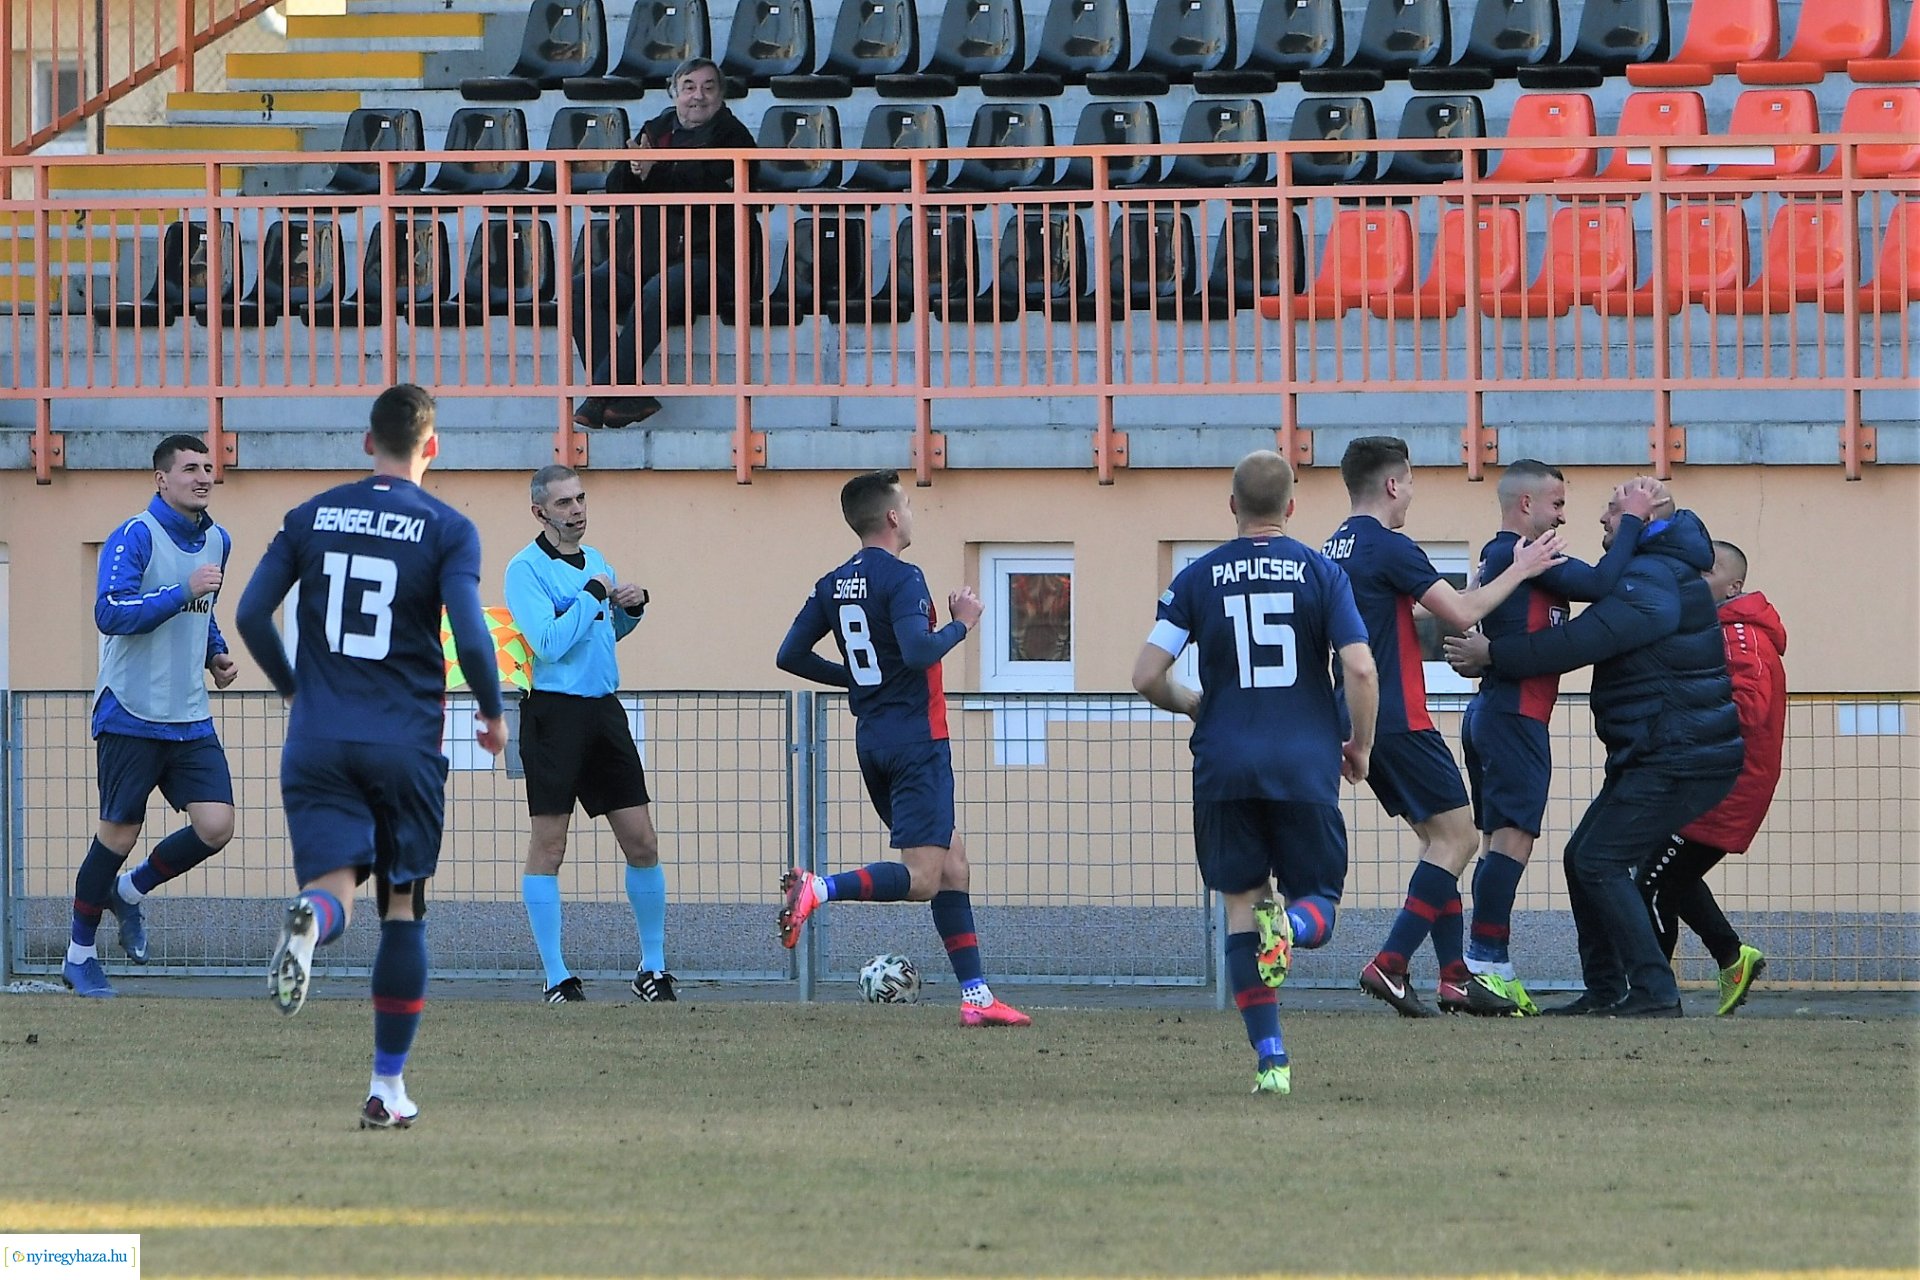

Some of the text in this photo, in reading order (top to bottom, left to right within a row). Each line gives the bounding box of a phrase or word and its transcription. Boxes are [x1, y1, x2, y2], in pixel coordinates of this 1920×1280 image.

[313, 507, 426, 543] GENGELICZKI
[832, 571, 868, 599] SIGÉR
[1211, 557, 1307, 587] PAPUCSEK
[180, 599, 209, 614] JAKO
[322, 551, 399, 661] 13
[838, 603, 883, 687] 8
[1223, 592, 1298, 689] 15
